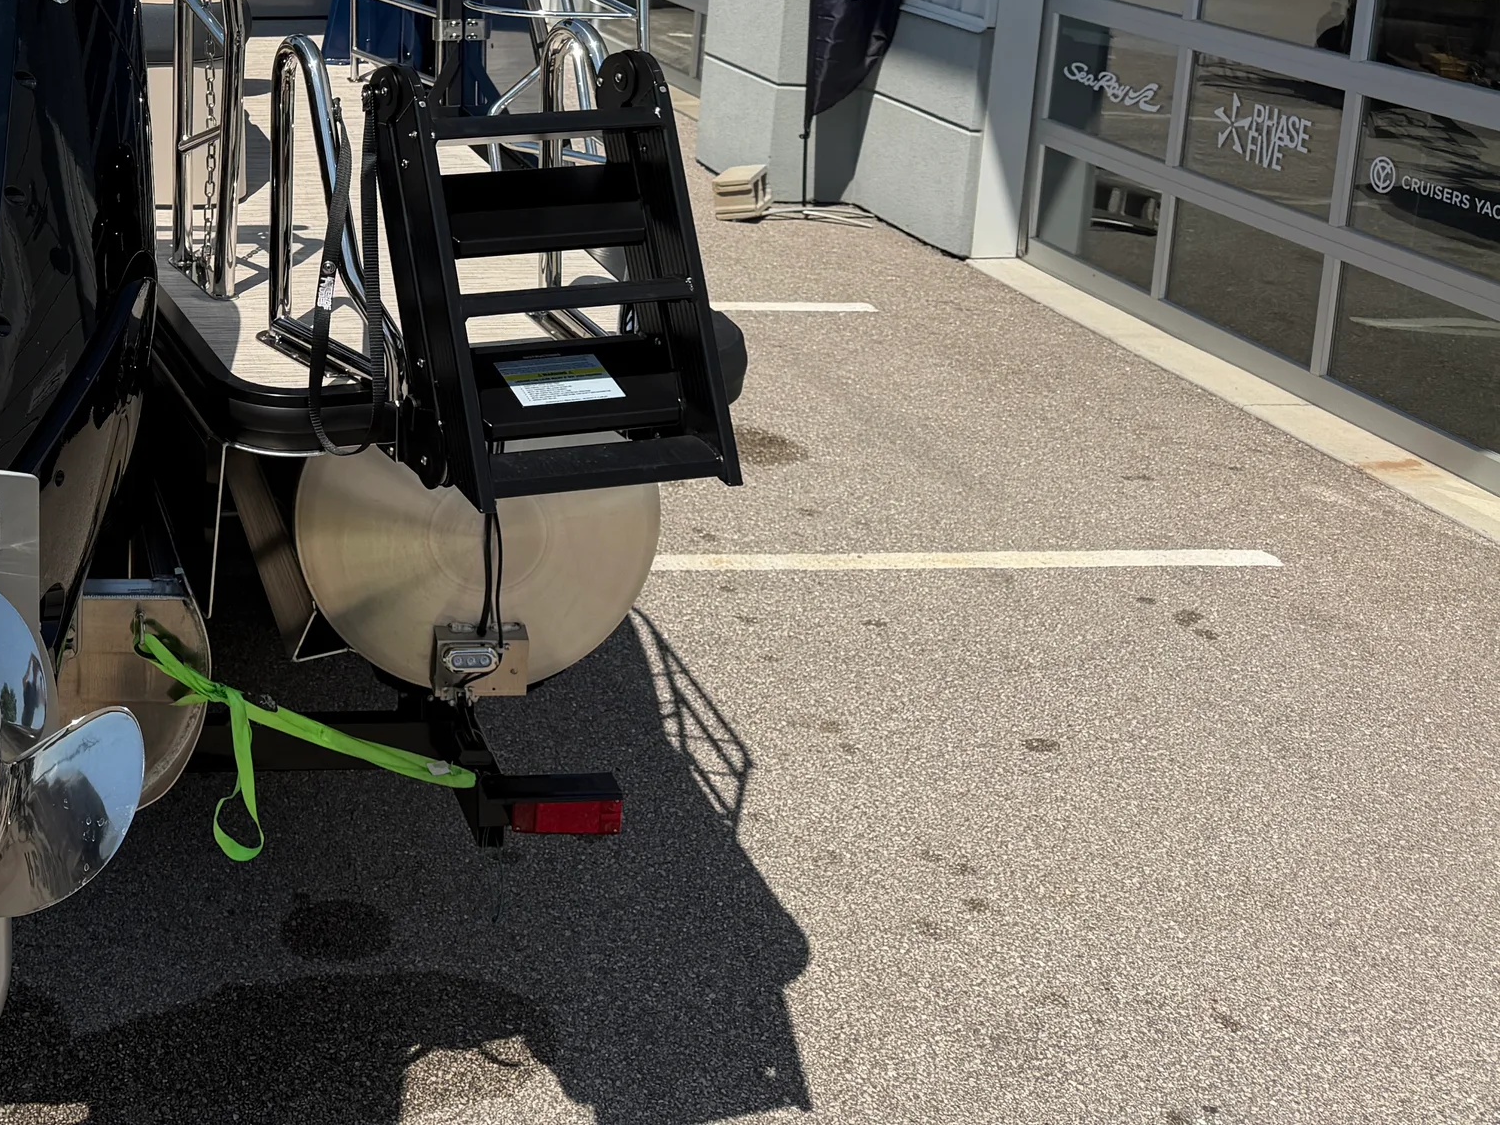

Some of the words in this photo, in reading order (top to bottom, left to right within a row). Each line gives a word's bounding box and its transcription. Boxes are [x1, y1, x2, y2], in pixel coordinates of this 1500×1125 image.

[1063, 62, 1098, 87] Sea
[1093, 71, 1131, 103] Ray
[1251, 103, 1312, 154] PHASE
[1245, 130, 1283, 172] FIVE
[1401, 175, 1470, 209] CRUISERS
